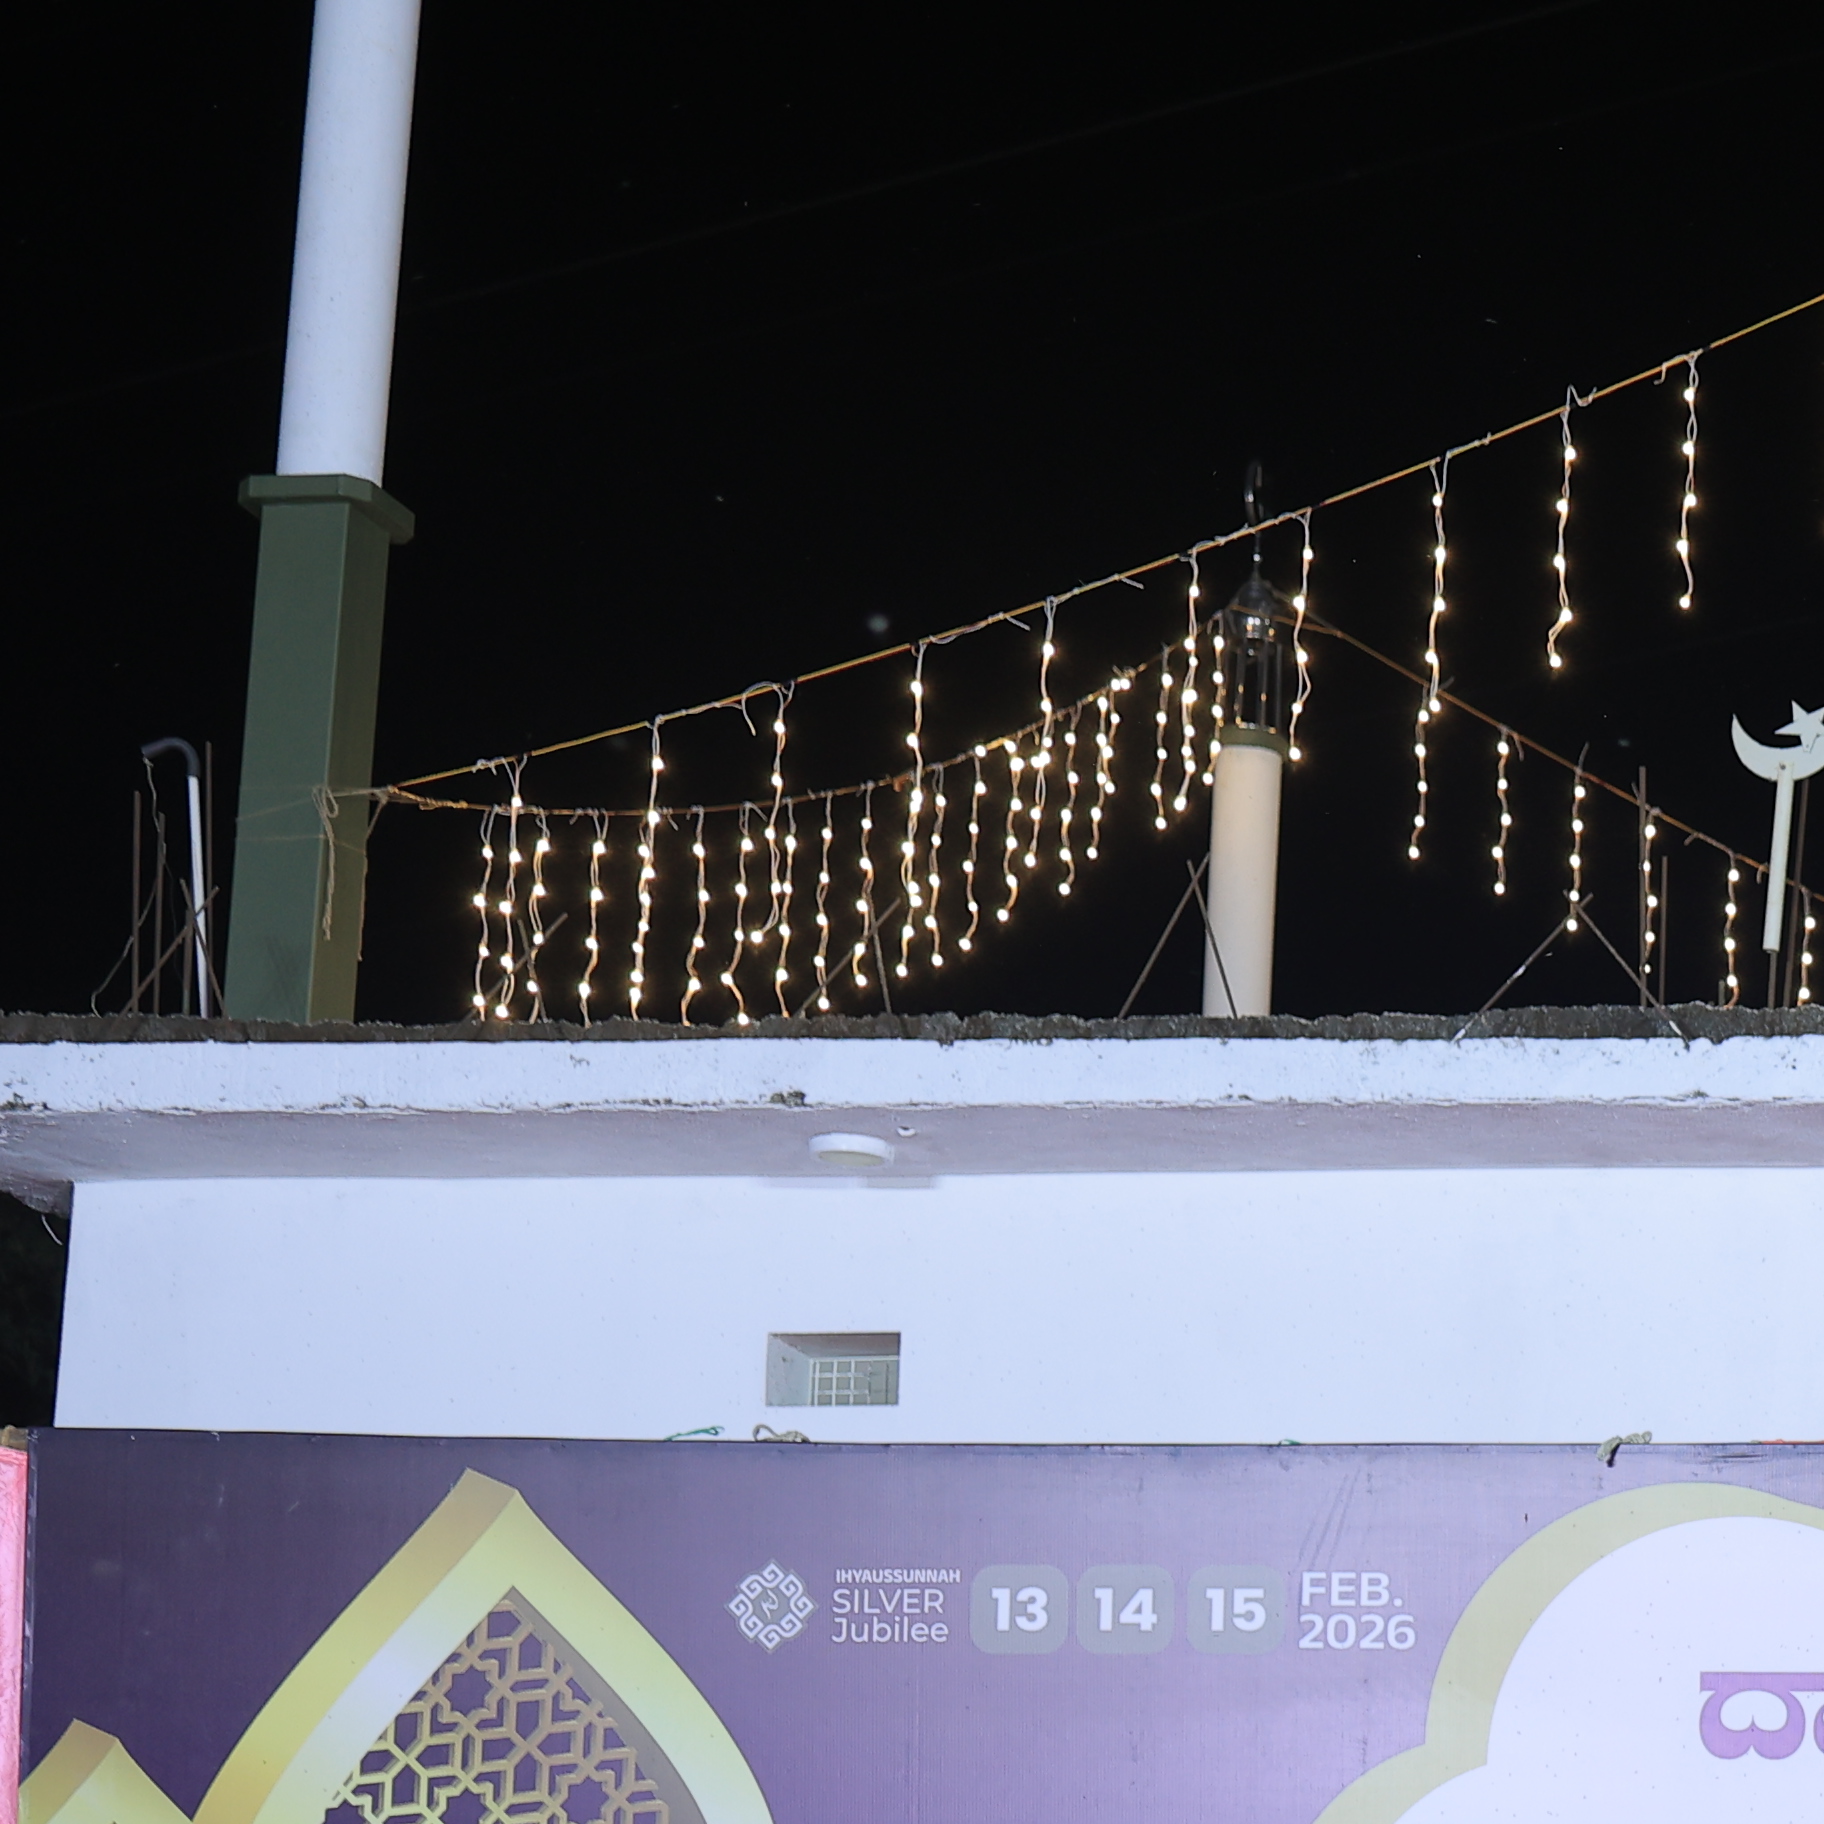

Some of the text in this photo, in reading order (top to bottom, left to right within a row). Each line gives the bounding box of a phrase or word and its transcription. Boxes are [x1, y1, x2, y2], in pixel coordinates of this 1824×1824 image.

[835, 1568, 962, 1584] IHYAUSSUNNAH
[1300, 1571, 1404, 1608] FEB.
[831, 1588, 945, 1615] SILVER
[991, 1586, 1267, 1633] 13 14 15
[831, 1618, 950, 1645] Jubilee
[1298, 1613, 1417, 1651] 2026
